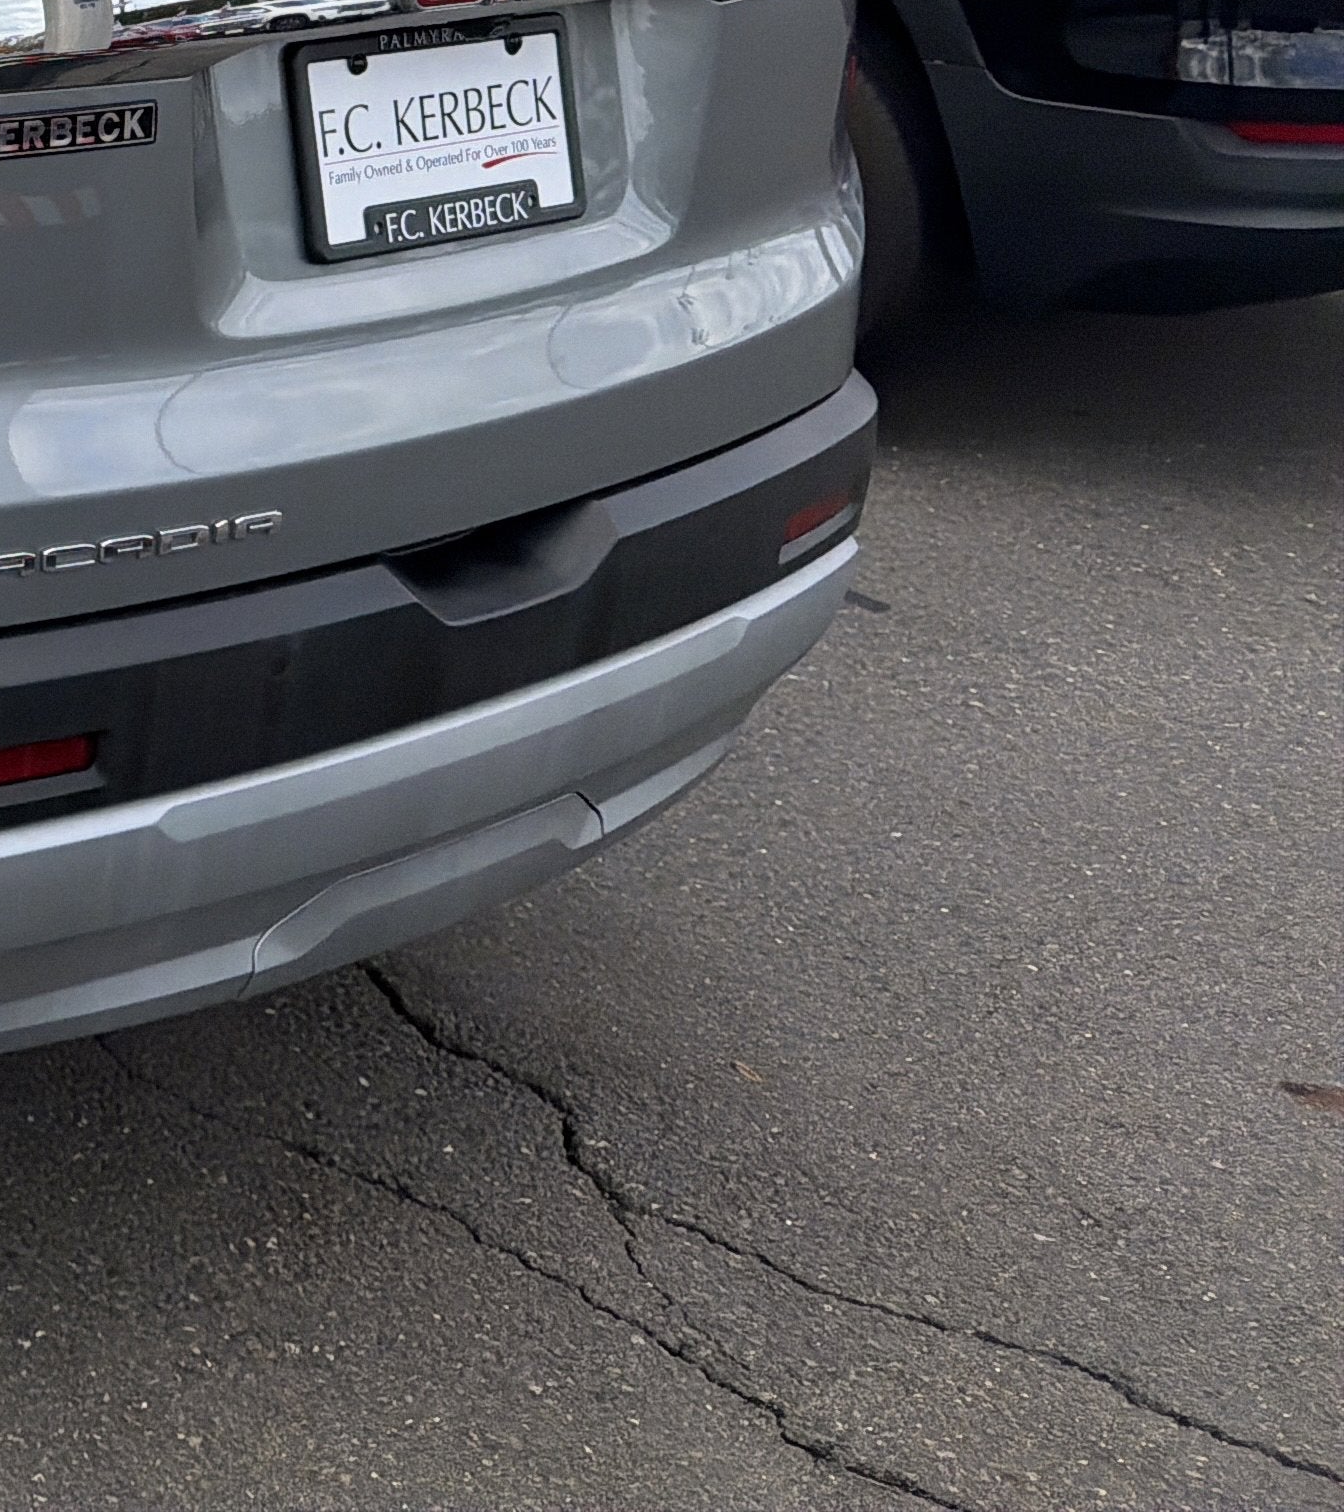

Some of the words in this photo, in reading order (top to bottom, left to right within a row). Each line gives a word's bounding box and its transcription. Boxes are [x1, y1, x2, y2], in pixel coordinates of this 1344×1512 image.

[317, 103, 383, 158] F.C.
[392, 75, 558, 147] KERBECK
[328, 165, 362, 186] Family
[364, 159, 403, 179] Owned
[404, 157, 414, 172] &
[415, 150, 464, 174] Operated
[465, 148, 482, 163] For
[484, 143, 510, 159] Over
[511, 139, 530, 154] 100
[530, 136, 557, 151] Years
[385, 209, 425, 244] F.C.
[428, 190, 529, 236] KERBECK
